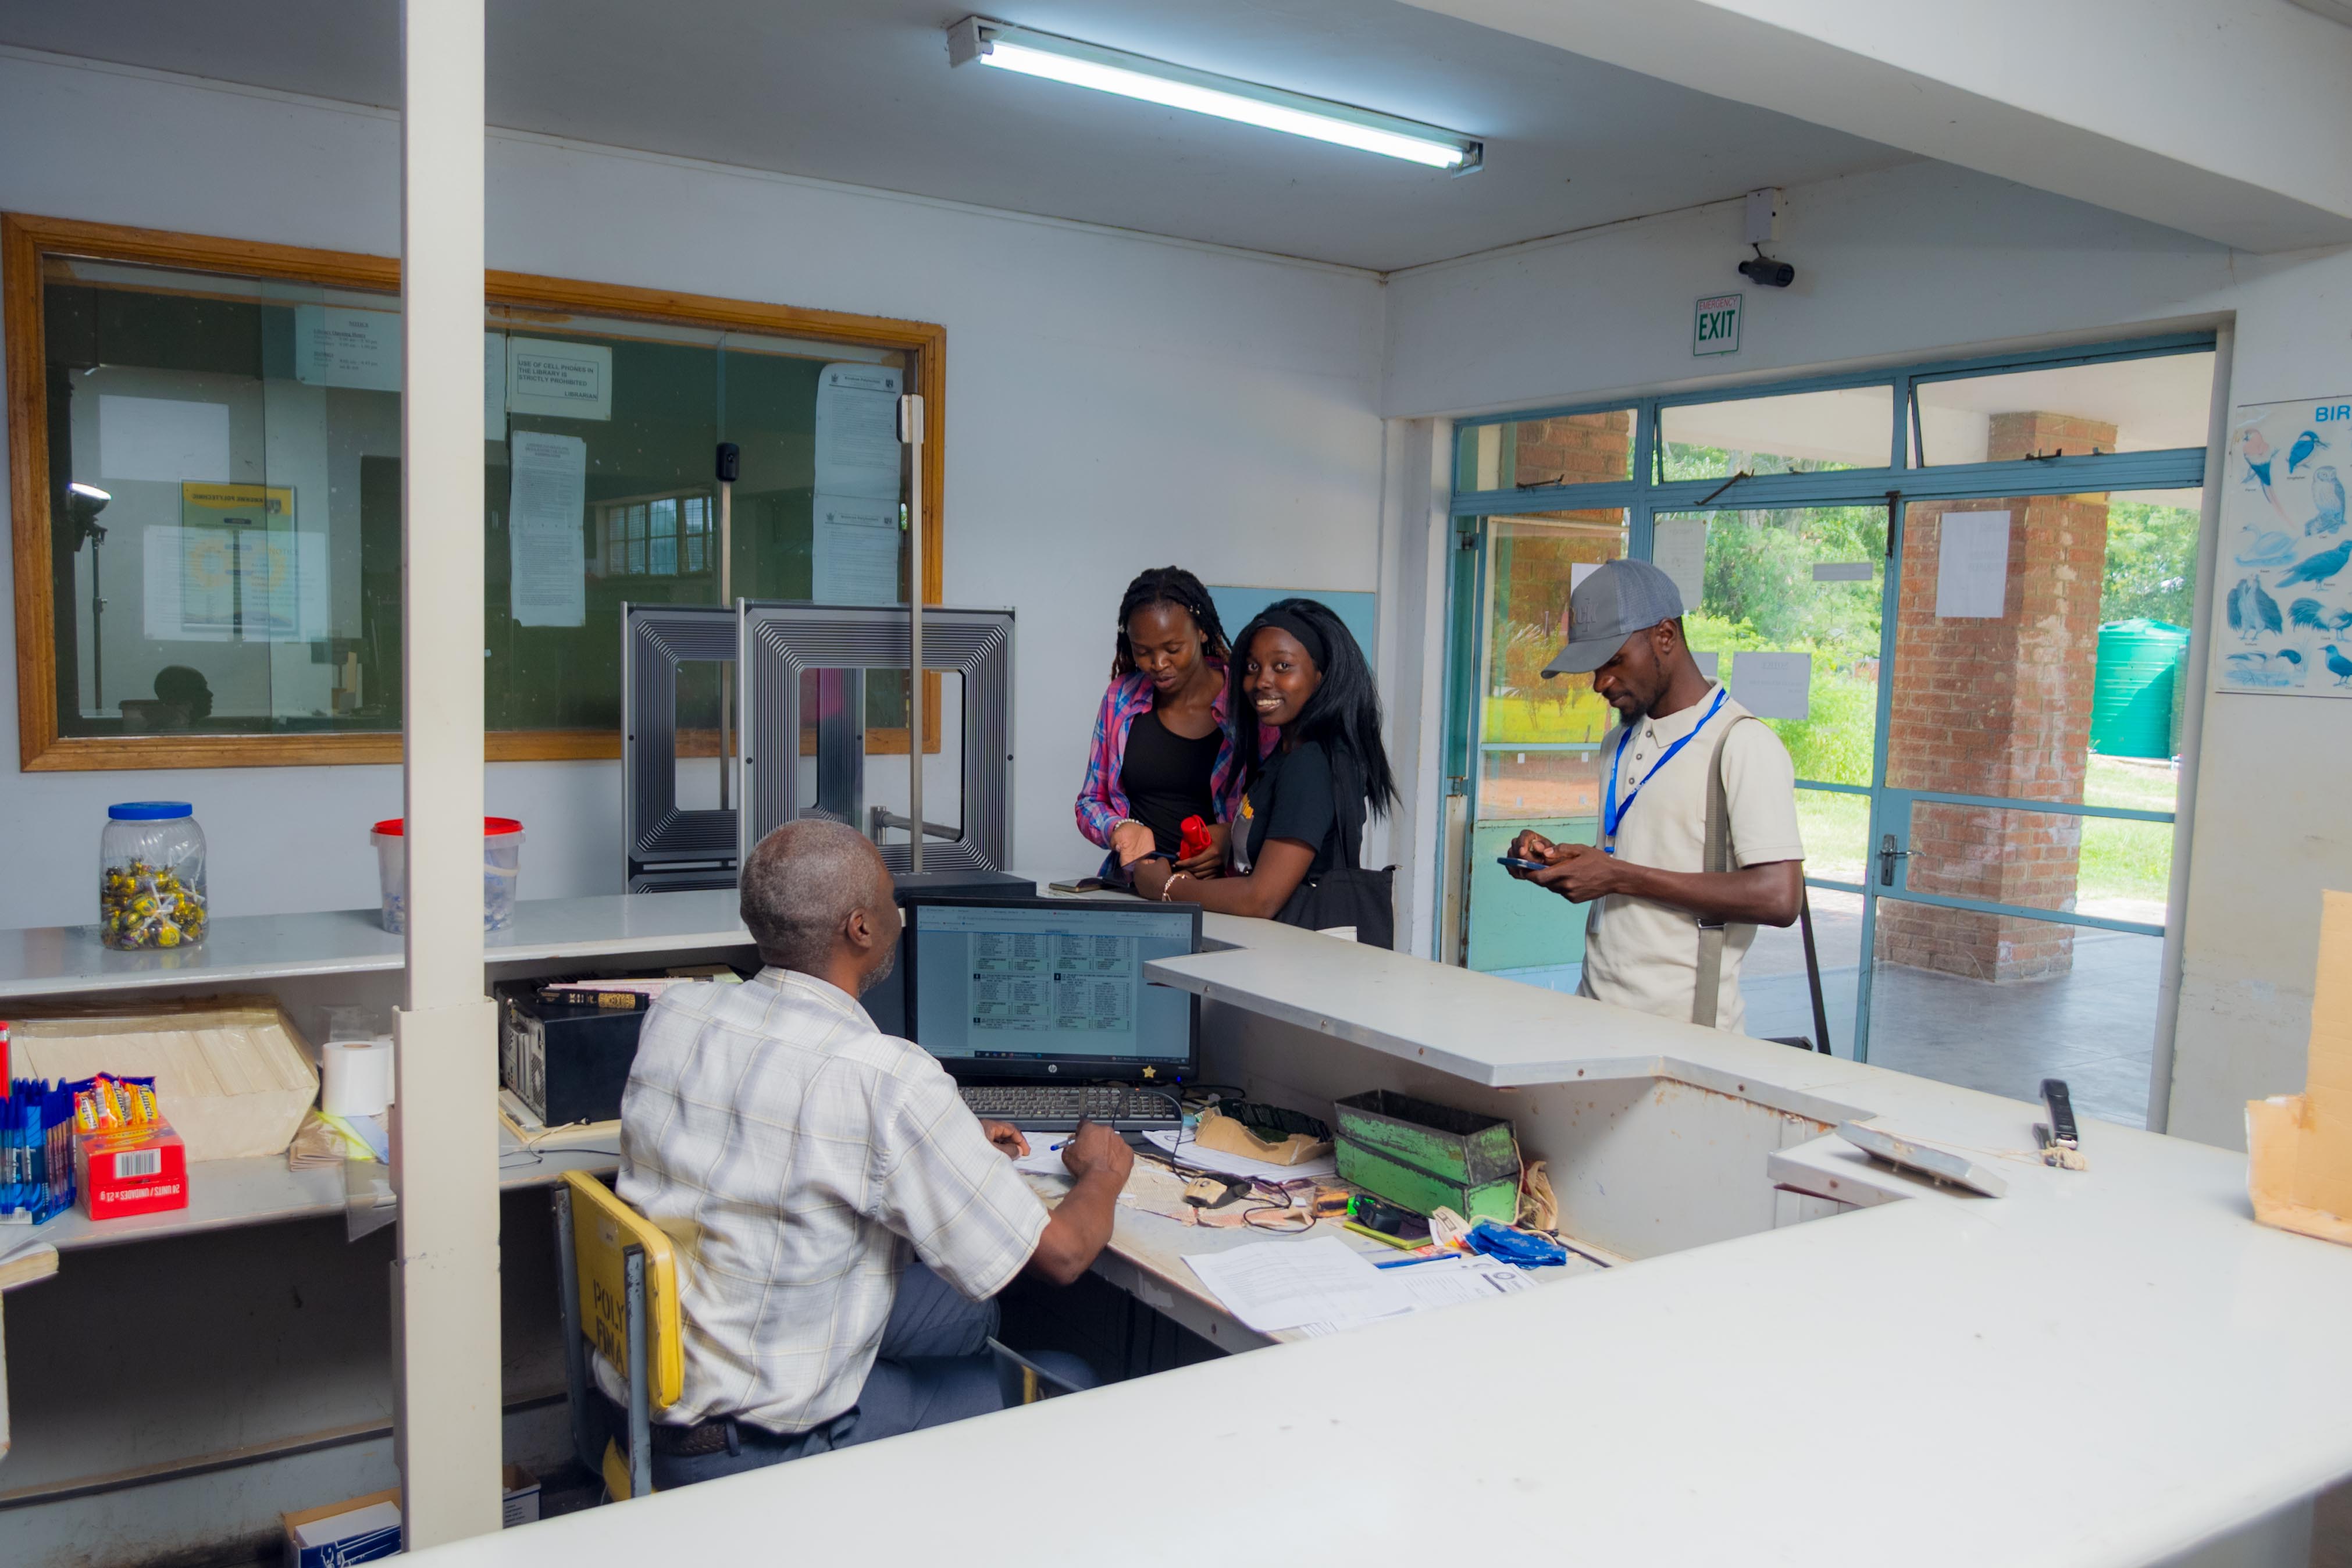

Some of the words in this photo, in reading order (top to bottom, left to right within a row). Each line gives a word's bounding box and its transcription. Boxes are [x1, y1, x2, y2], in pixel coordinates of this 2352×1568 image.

[1699, 297, 1737, 310] EMERGENCY
[1699, 309, 1736, 341] EXIT
[533, 369, 560, 377] LIBRARY
[550, 377, 587, 386] PROHIBITED
[565, 391, 597, 399] LIBRARIAN
[2315, 405, 2350, 422] BIR
[1048, 1064, 1057, 1073] hp
[139, 1089, 154, 1117] Lunch
[154, 1185, 172, 1196] UNITS
[173, 1184, 180, 1193] 24
[101, 1191, 105, 1200] g
[107, 1192, 114, 1202] 21
[120, 1188, 149, 1200] UNIDADES
[593, 1279, 624, 1332] POLY
